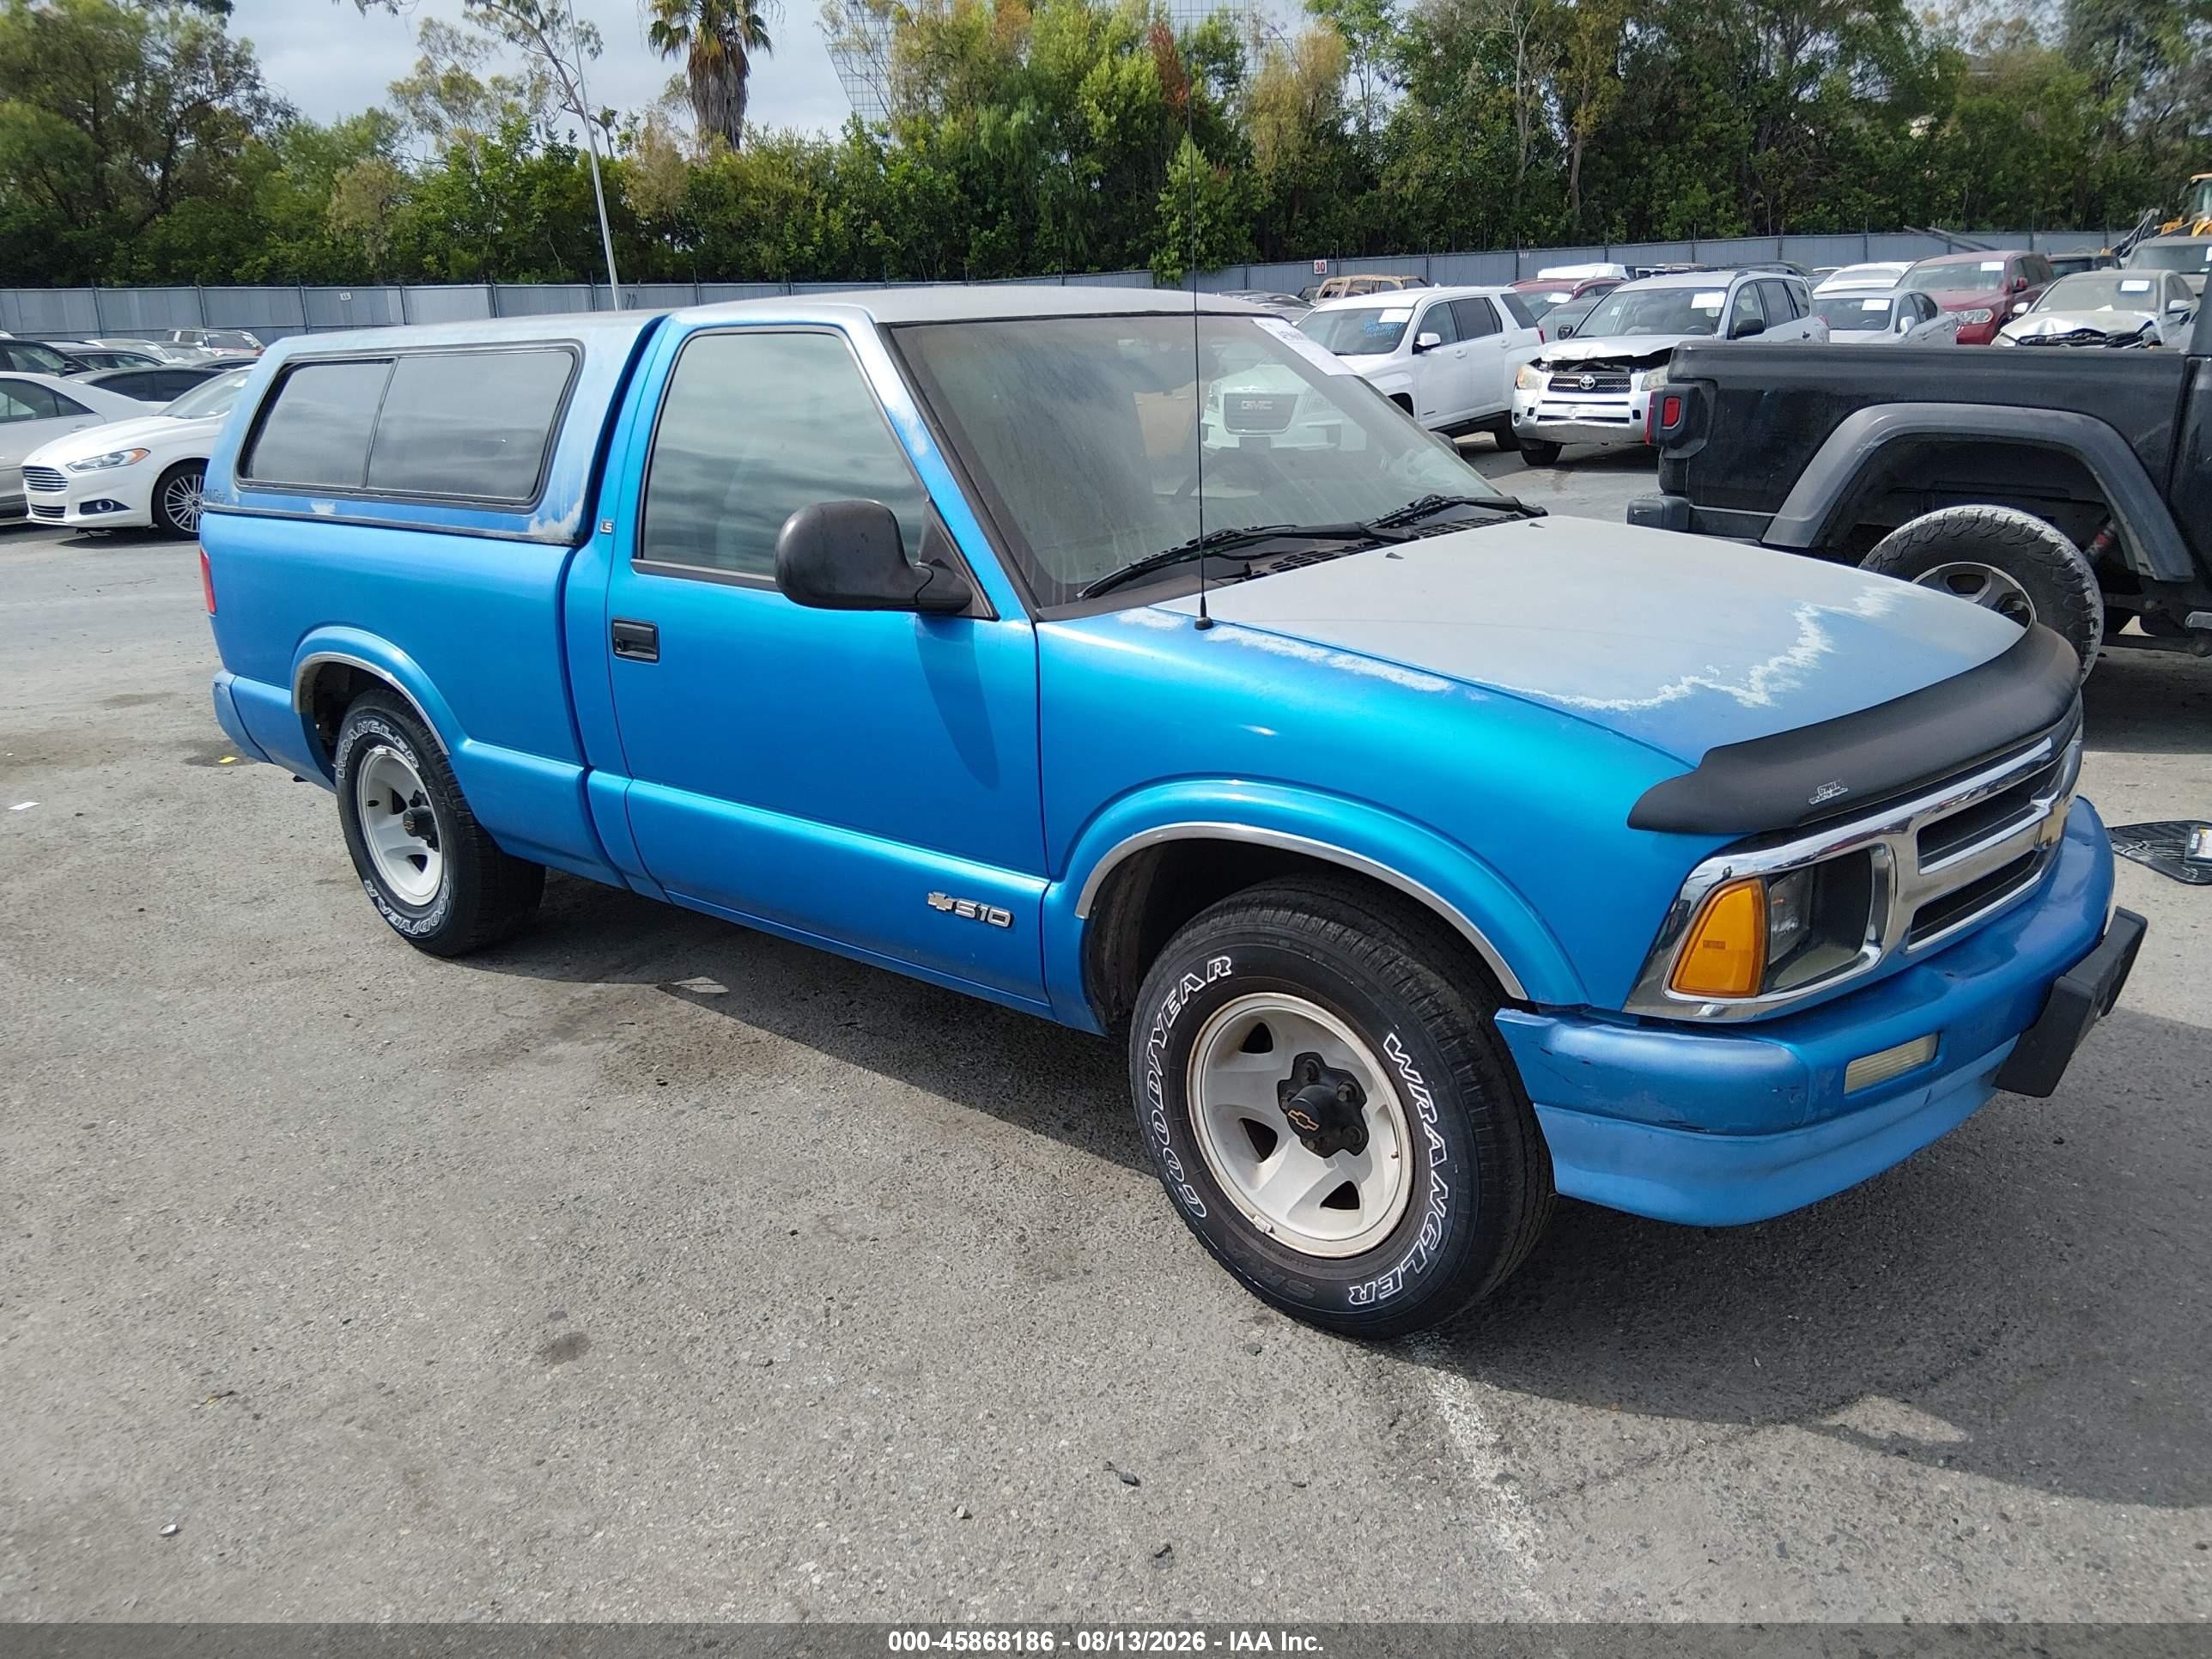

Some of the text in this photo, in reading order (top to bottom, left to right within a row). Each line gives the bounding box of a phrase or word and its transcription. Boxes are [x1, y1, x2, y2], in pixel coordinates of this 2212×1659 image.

[1315, 261, 1326, 272] 30
[1241, 400, 1273, 410] GMC
[600, 522, 613, 533] LS
[955, 900, 1011, 927] S10
[1146, 956, 1232, 1219] GOODYEAR
[1348, 1033, 1449, 1305] WRANGLER
